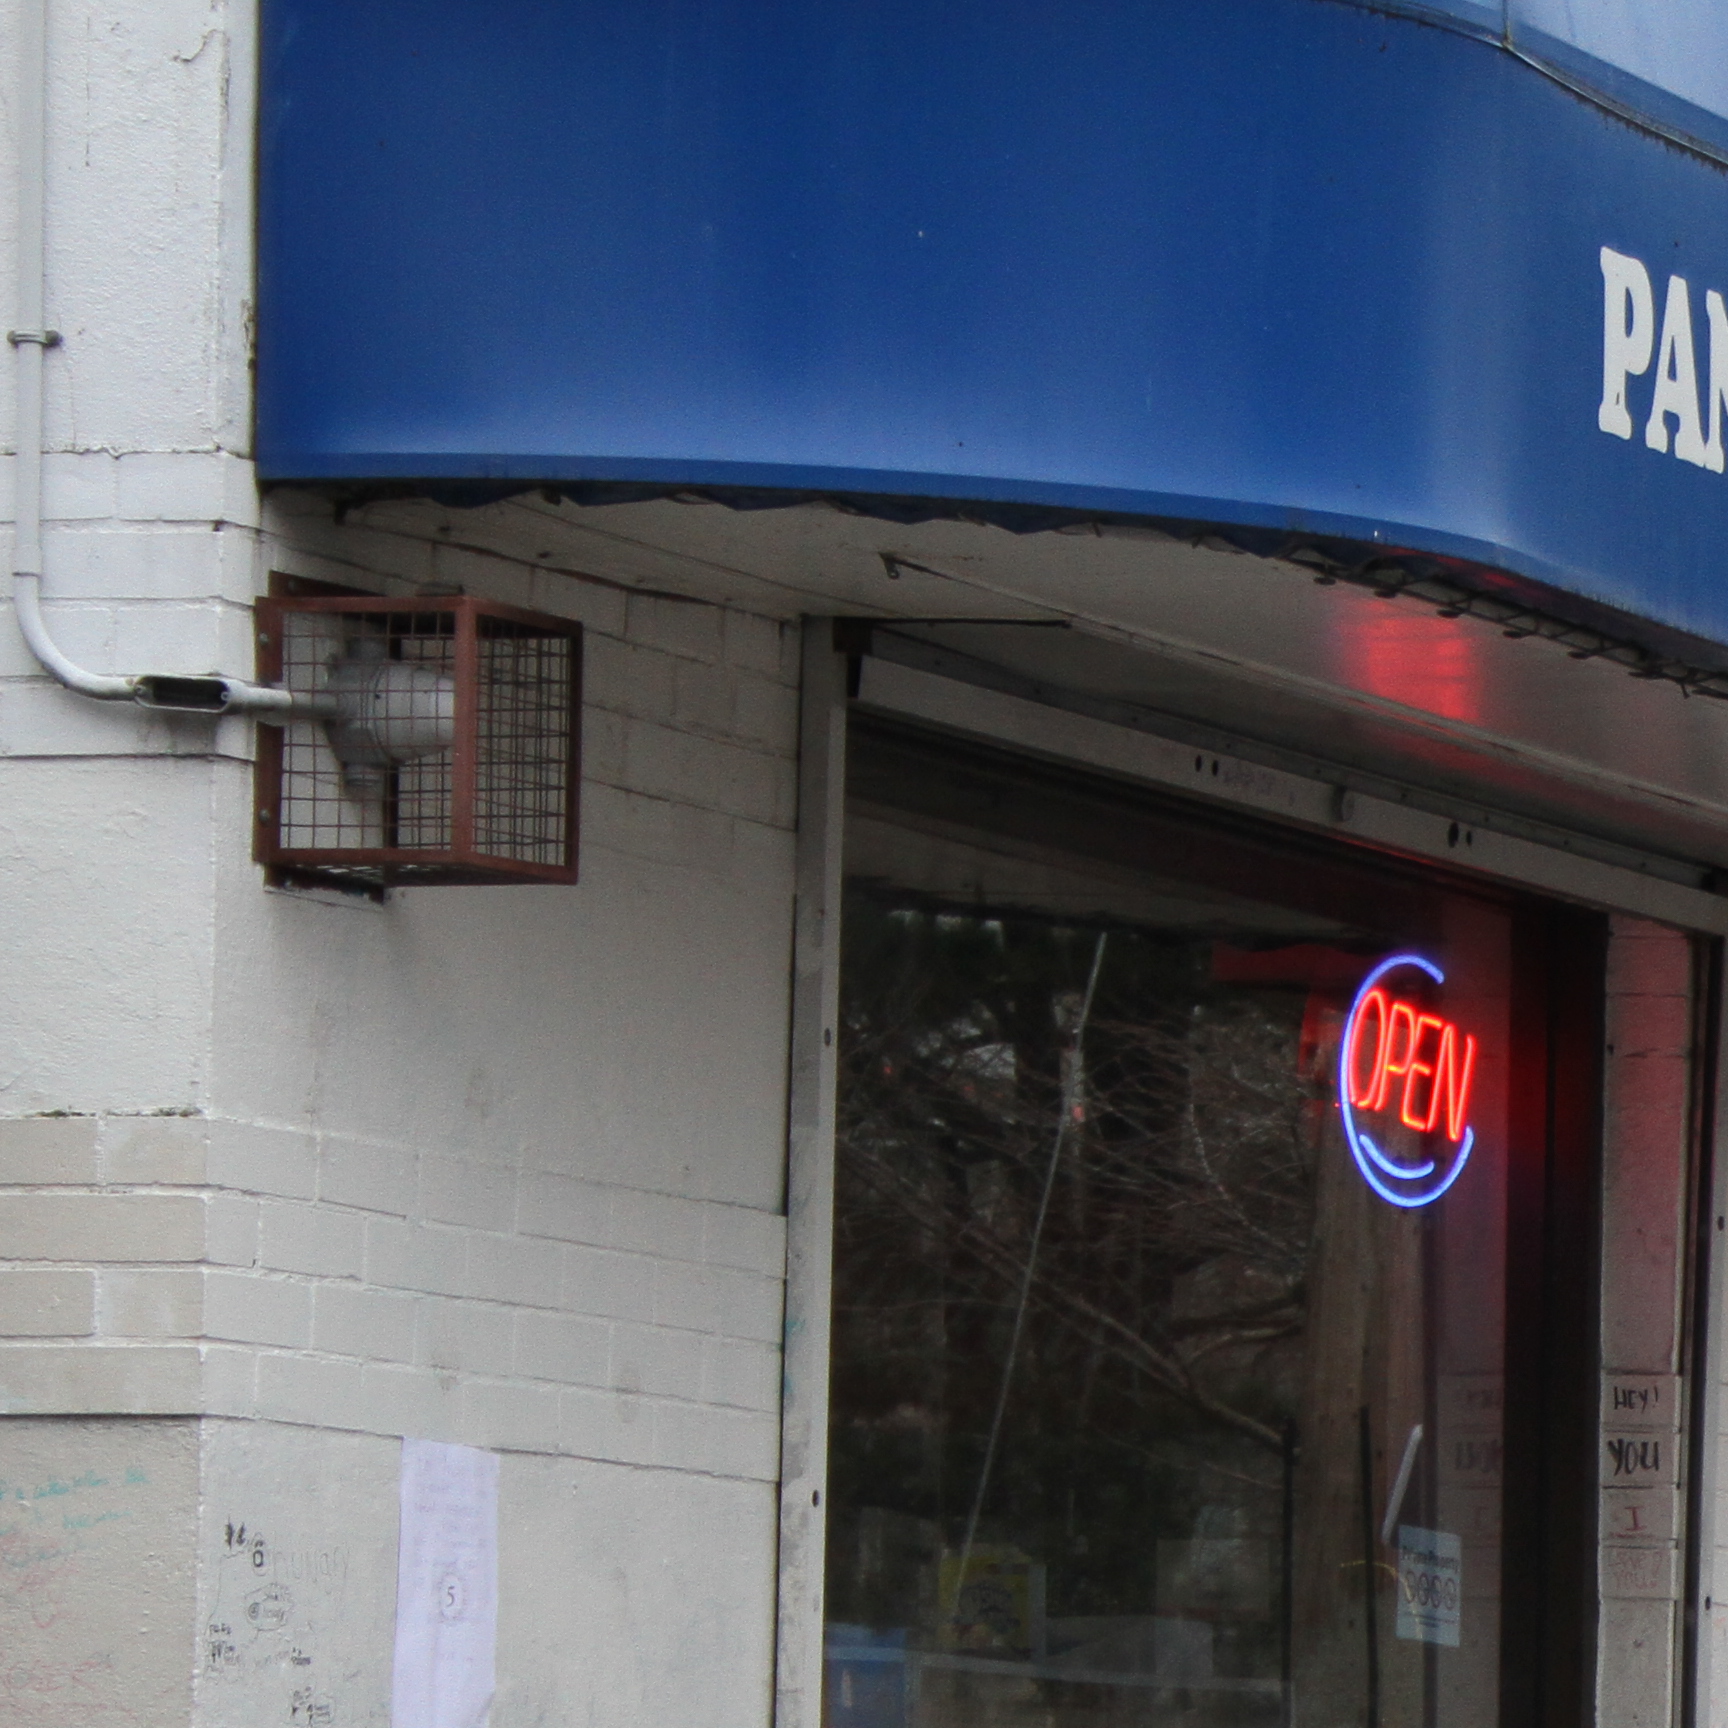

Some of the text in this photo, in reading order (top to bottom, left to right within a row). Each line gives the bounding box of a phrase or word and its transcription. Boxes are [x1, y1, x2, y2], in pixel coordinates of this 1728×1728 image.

[1347, 986, 1475, 1142] OPEN
[1613, 1386, 1659, 1412] HEY!
[1607, 1438, 1660, 1477] YOU
